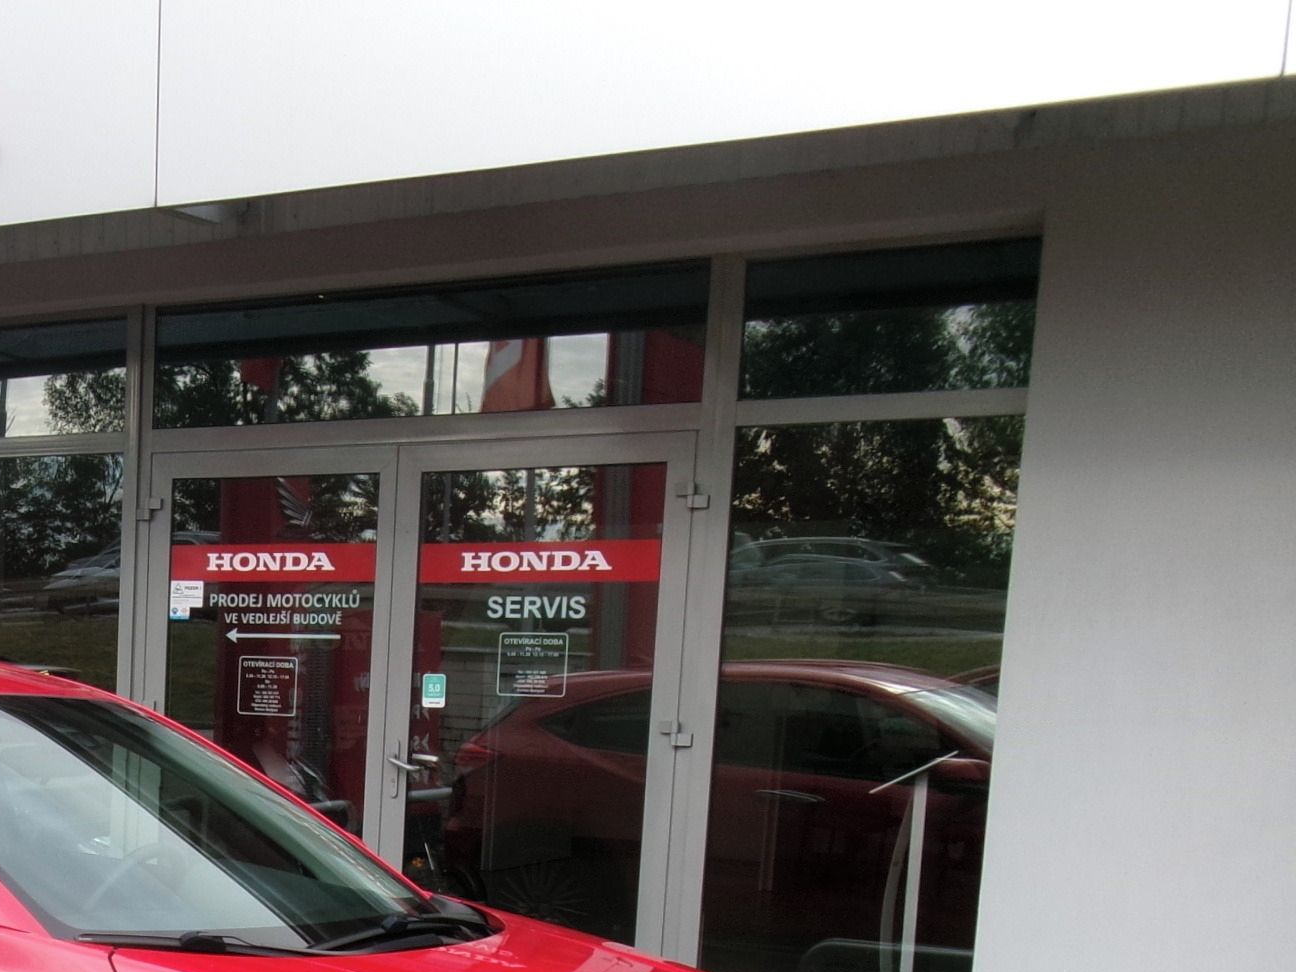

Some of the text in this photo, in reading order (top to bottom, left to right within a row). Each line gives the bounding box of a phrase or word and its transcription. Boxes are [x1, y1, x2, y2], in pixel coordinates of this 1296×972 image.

[206, 551, 335, 572] HONDA
[461, 550, 613, 572] HONDA
[209, 593, 263, 608] PRODEJ
[266, 589, 360, 608] MOTOCYKLŮ
[486, 595, 587, 619] SERVIS
[224, 610, 343, 625] VE VEDLEJŠÍ BUDOVĚ
[275, 661, 295, 669] DOBA
